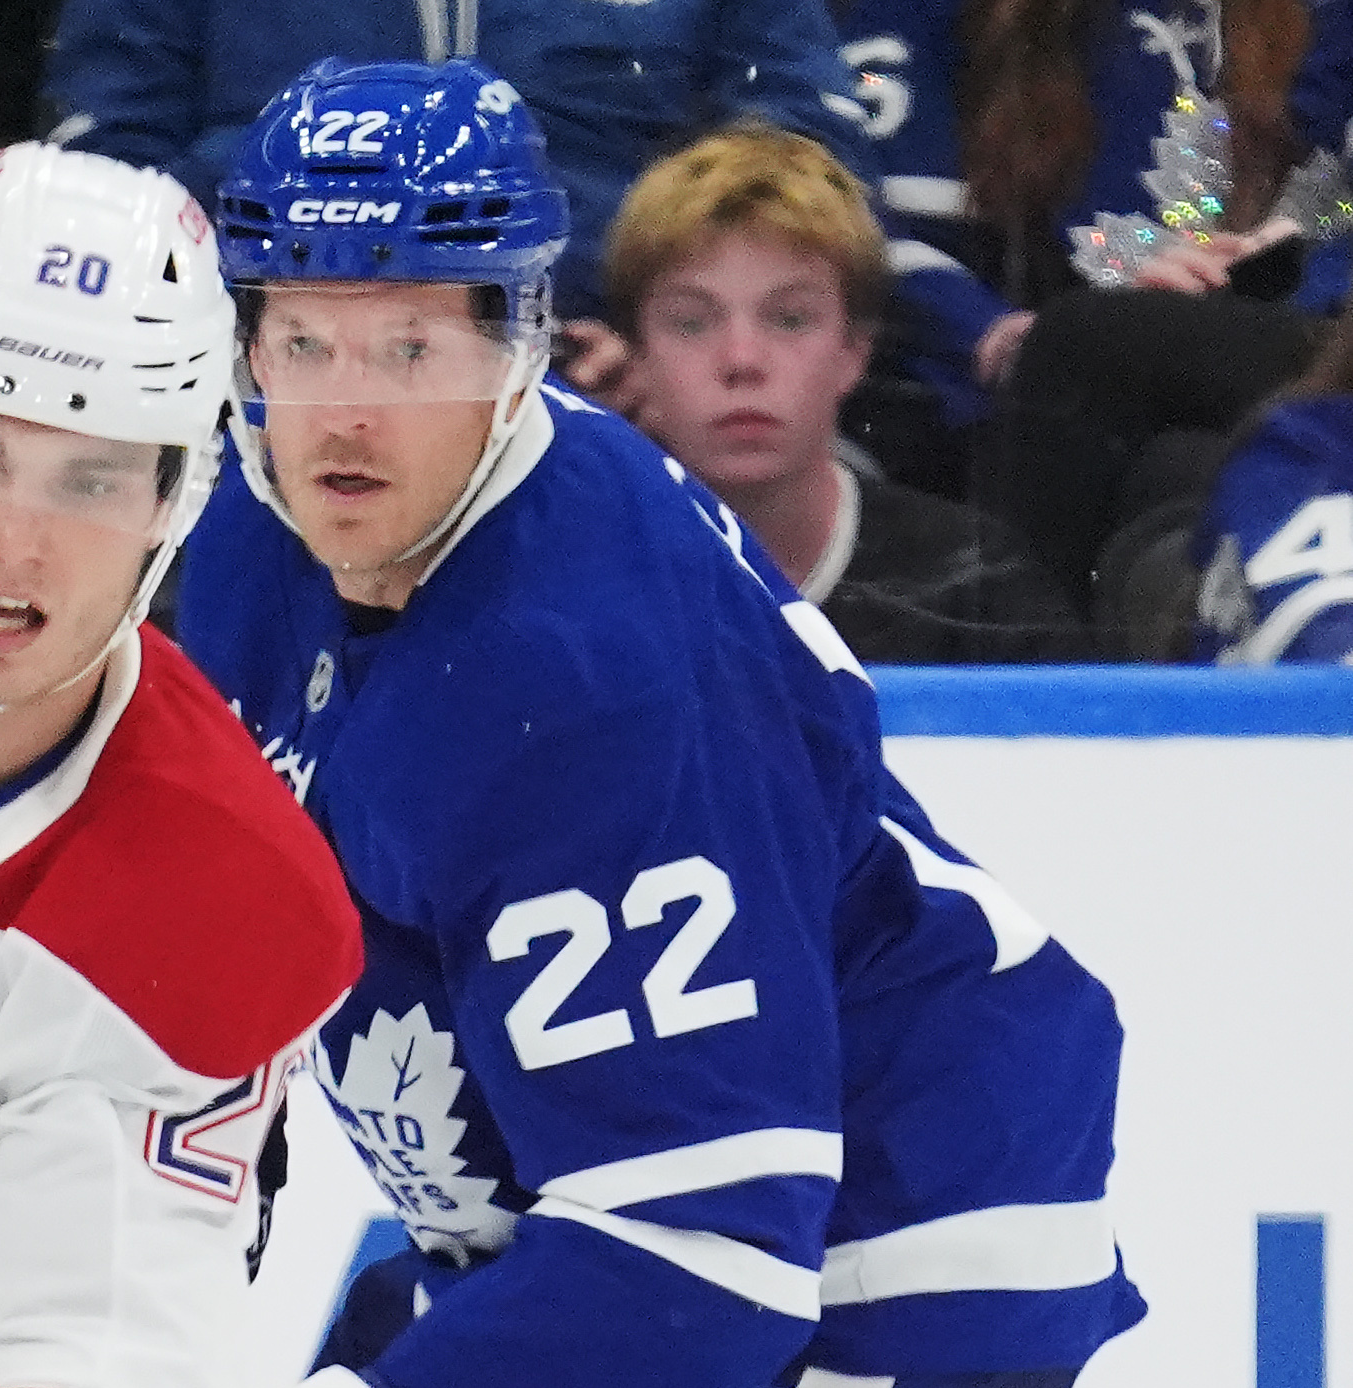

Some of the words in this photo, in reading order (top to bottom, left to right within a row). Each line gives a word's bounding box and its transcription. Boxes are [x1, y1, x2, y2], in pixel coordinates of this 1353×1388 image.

[311, 109, 390, 153] 22
[287, 199, 402, 223] CCM
[36, 246, 111, 296] 20
[486, 854, 758, 1070] 22
